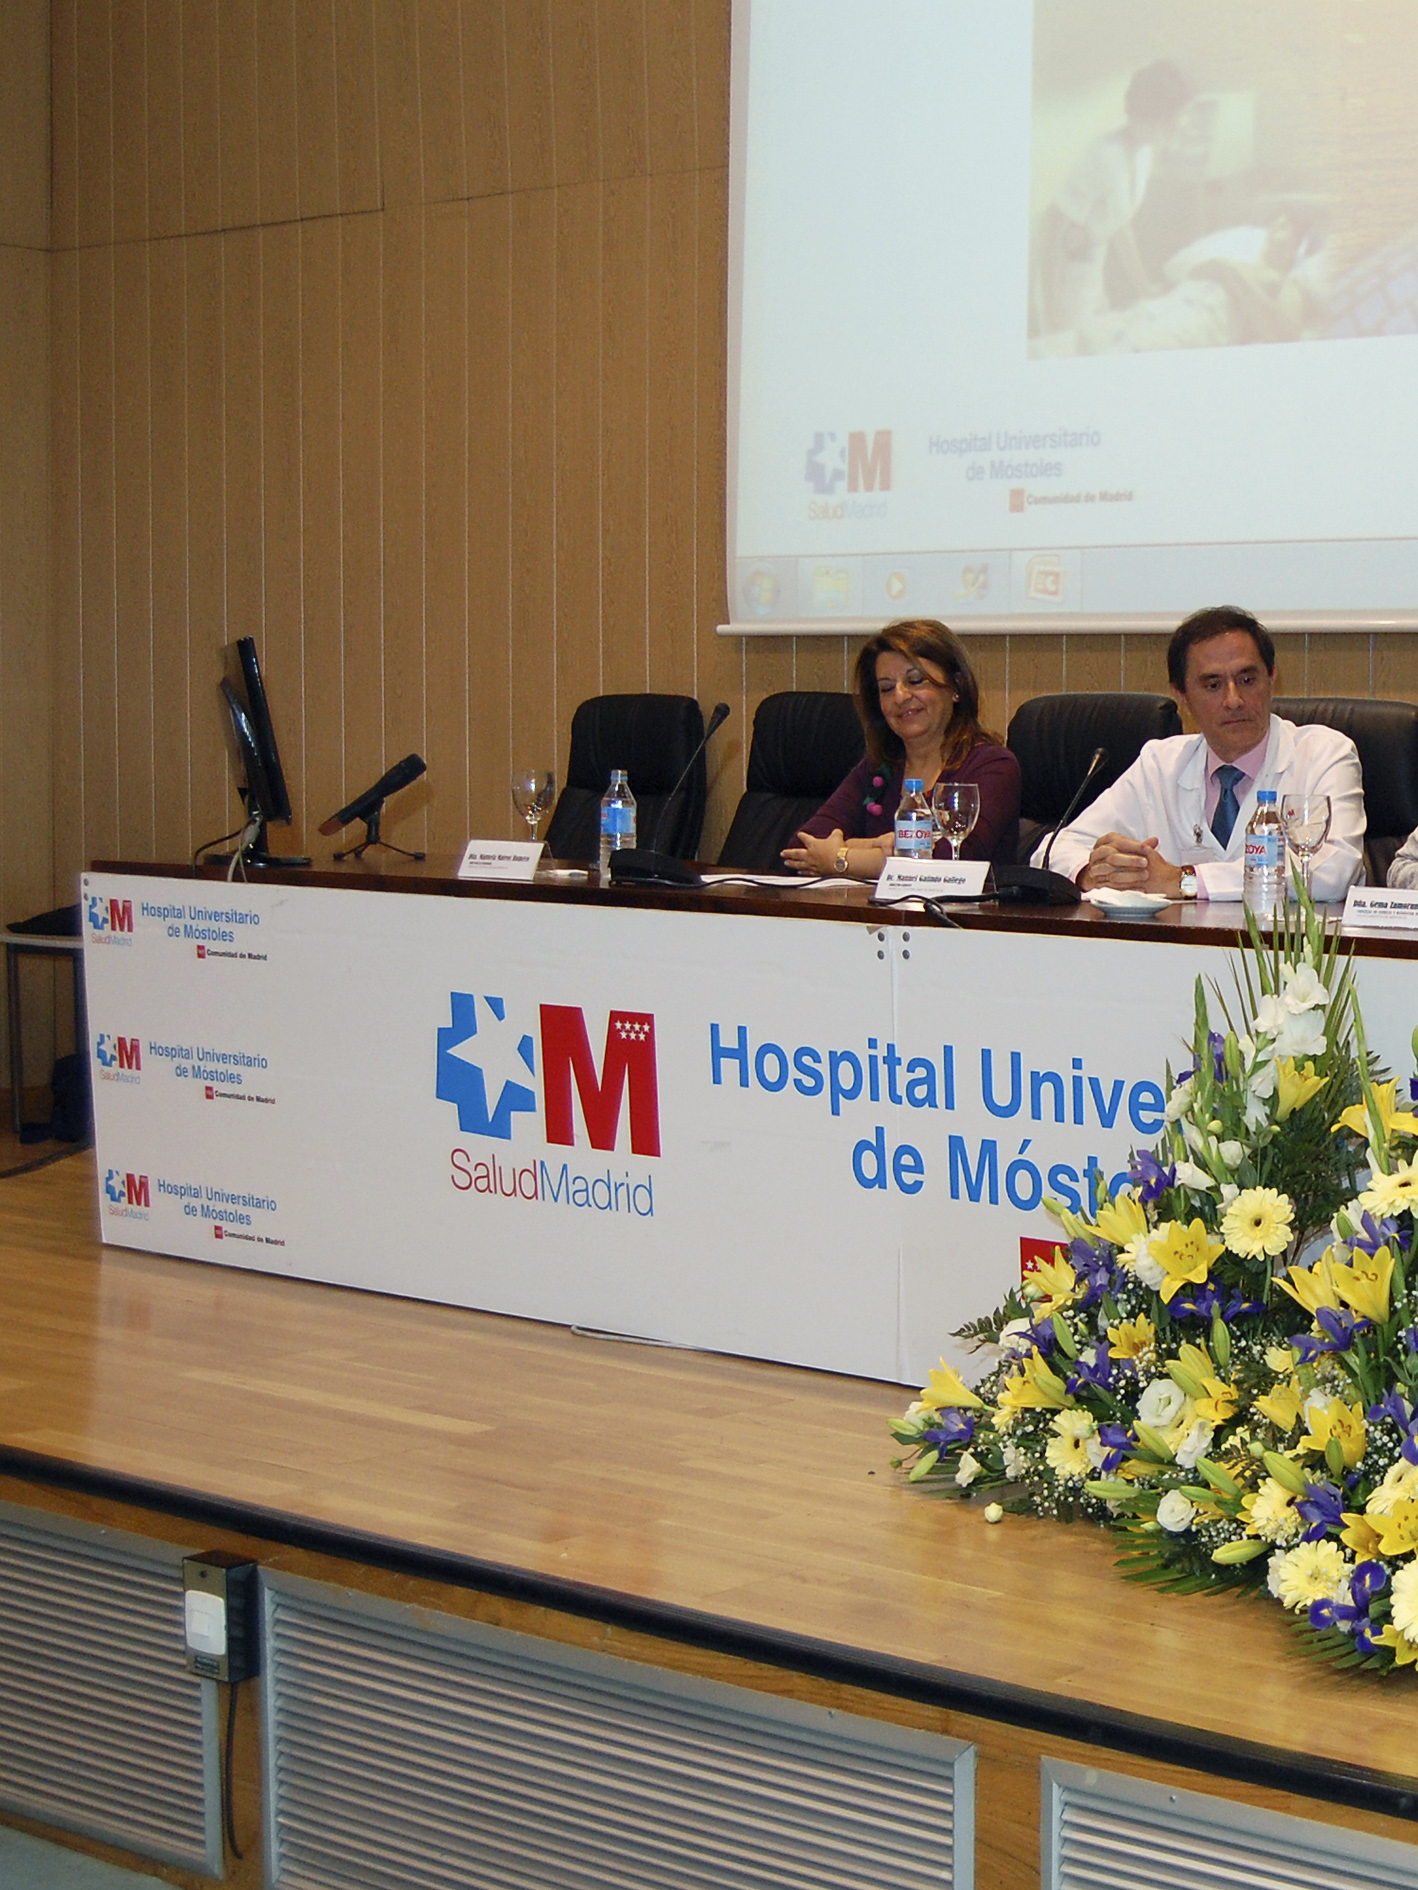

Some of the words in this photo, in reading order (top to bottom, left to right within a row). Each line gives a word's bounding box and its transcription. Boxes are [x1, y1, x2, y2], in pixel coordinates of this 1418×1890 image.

[929, 433, 992, 457] Hospital
[996, 427, 1101, 451] Universitario
[966, 463, 985, 481] de
[990, 458, 1063, 479] Móstoles
[141, 903, 185, 921] Hospital
[189, 906, 260, 926] Universitario
[167, 925, 180, 938] de
[184, 924, 235, 943] Móstoles
[206, 949, 238, 959] Comunidad
[248, 952, 267, 961] Madrid
[149, 1041, 193, 1061] Hospital
[196, 1047, 268, 1069] Universitario
[175, 1064, 188, 1078] de
[192, 1064, 243, 1085] Móstoles
[710, 1023, 956, 1116] Hospital
[215, 1090, 246, 1101] Comunidad
[256, 1095, 276, 1105] Madrid
[852, 1126, 924, 1195] de
[450, 1149, 654, 1217] SaludMadrid
[158, 1179, 202, 1200] Hospital
[205, 1187, 277, 1211] Universitario
[184, 1202, 197, 1217] de
[201, 1204, 252, 1226] Móstoles
[224, 1230, 255, 1242] Comunidad
[265, 1236, 285, 1246] Madrid
